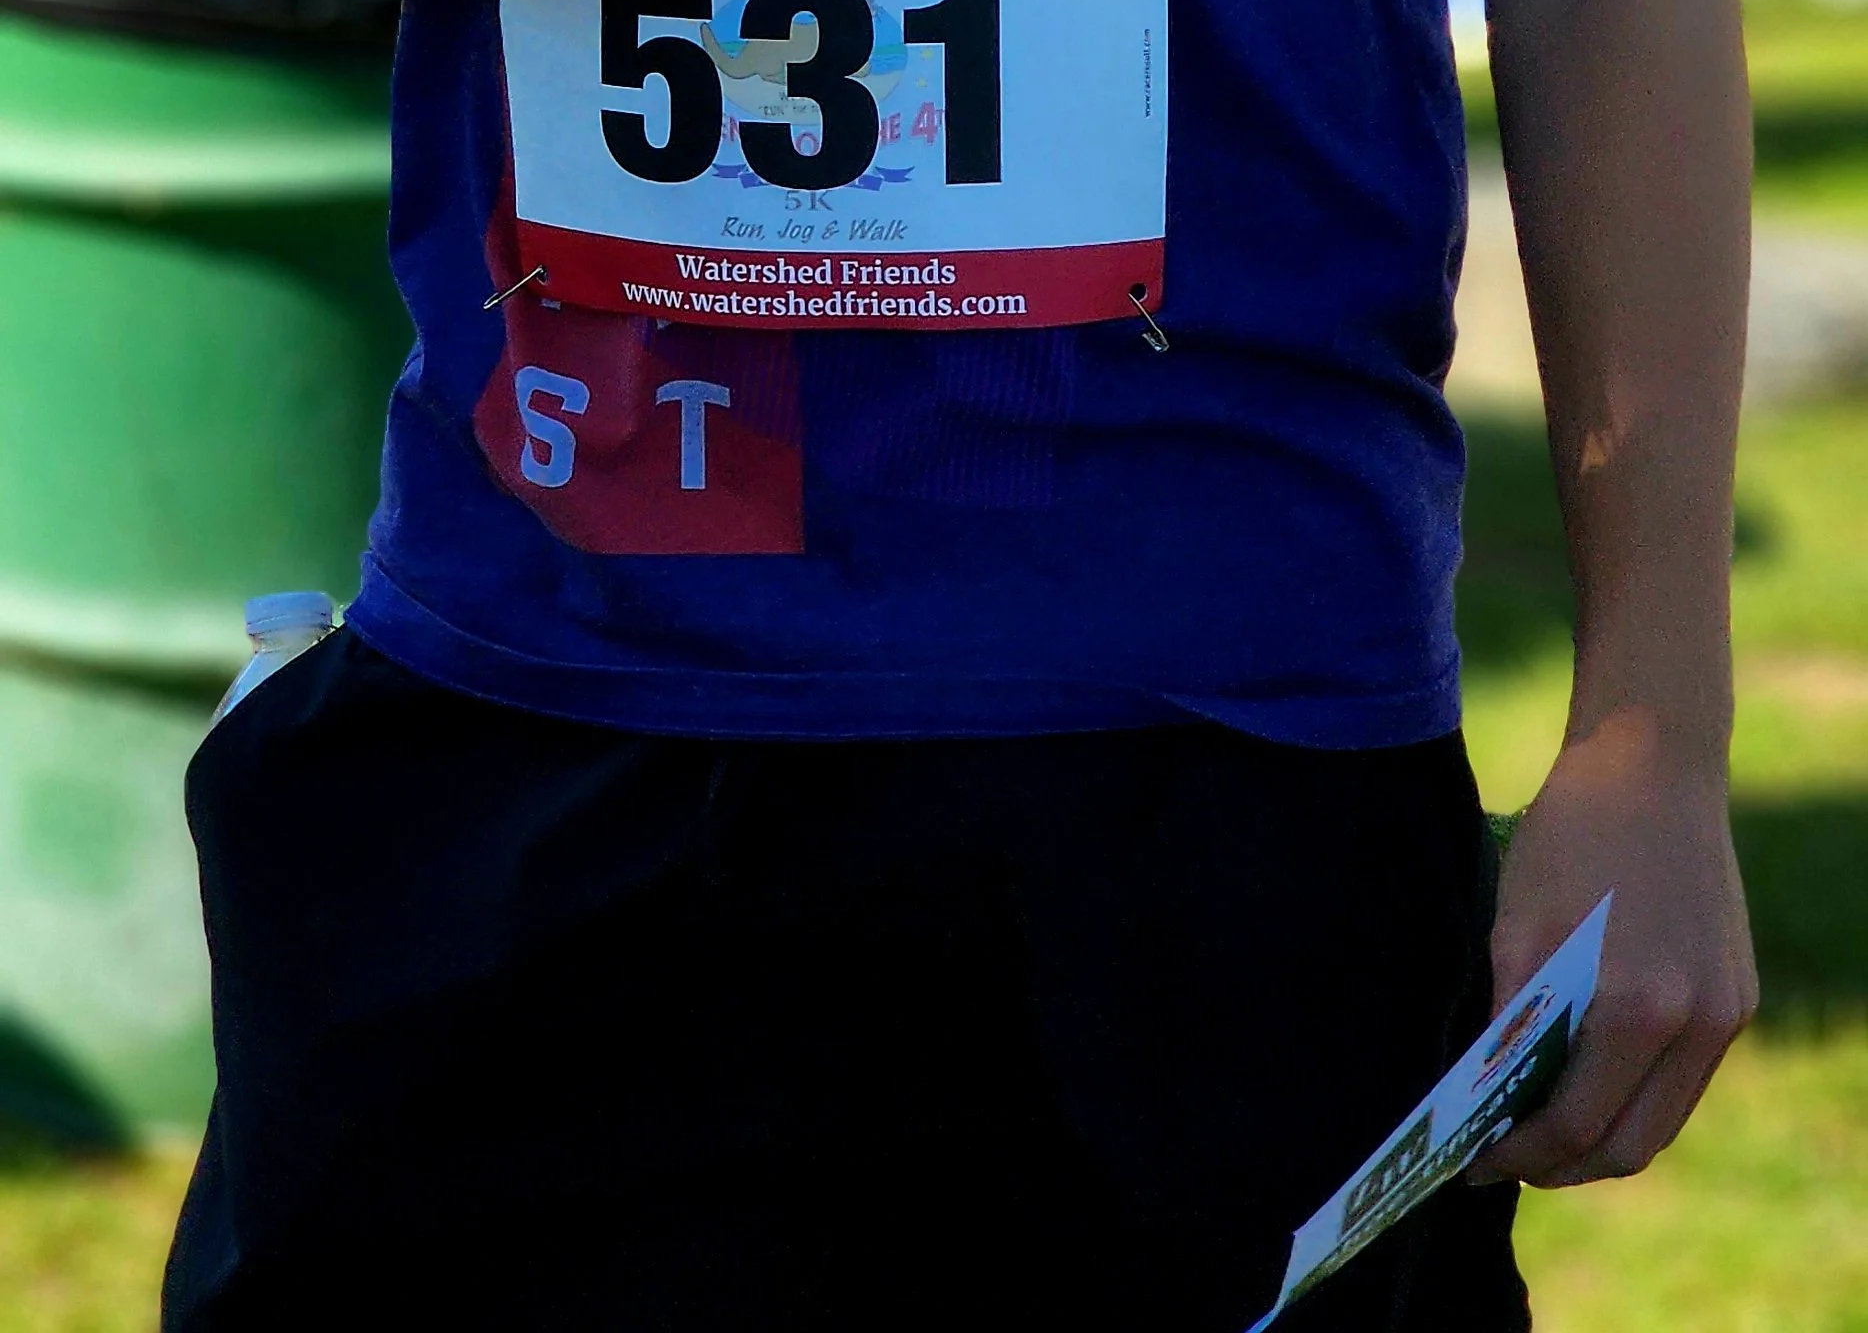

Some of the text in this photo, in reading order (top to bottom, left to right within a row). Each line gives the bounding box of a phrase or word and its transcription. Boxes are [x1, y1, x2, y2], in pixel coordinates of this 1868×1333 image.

[721, 216, 908, 244] Run, Jog & Walk
[675, 253, 956, 286] Watershed Friends
[622, 281, 1027, 318] www.watershedfriends.com
